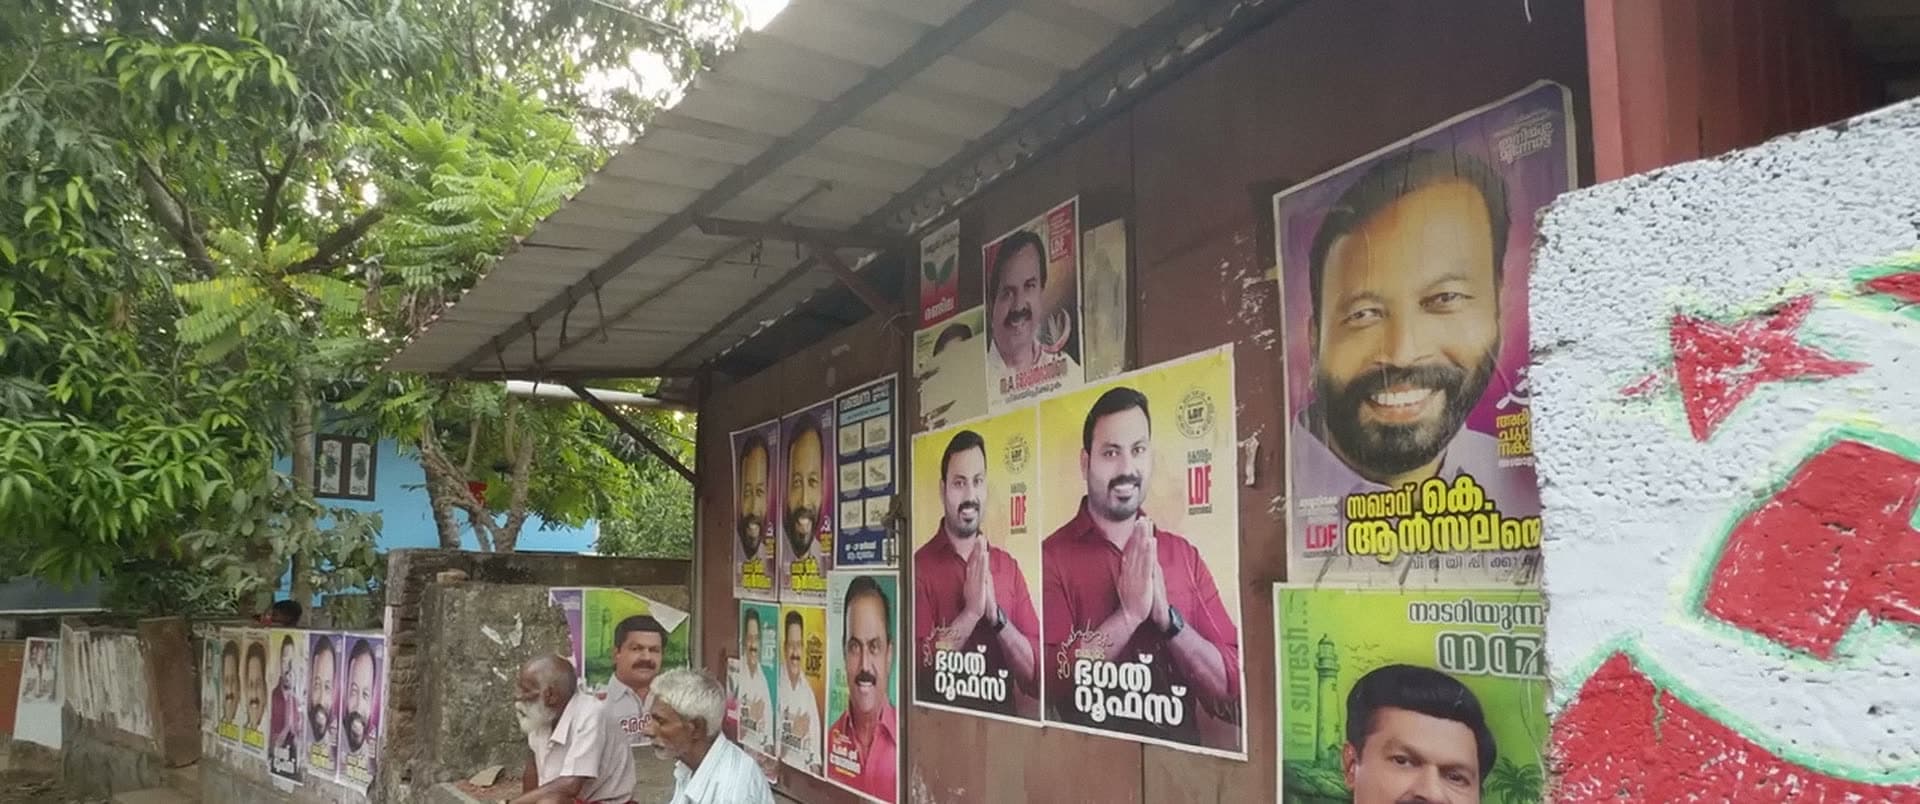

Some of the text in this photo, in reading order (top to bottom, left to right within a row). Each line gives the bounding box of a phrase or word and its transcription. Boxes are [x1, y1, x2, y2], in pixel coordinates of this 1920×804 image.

[1188, 465, 1212, 506] LDF
[1347, 483, 1415, 519] സഖാവ്
[1422, 475, 1494, 514] കെ.
[1010, 495, 1027, 527] LDF
[1306, 524, 1338, 549] LDF
[1409, 599, 1544, 630] നാടറിയുന്ന
[935, 644, 987, 676] ഭഗത്
[1074, 653, 1154, 693] ഭഗത്
[935, 668, 1009, 702] റൂഫസ്
[1074, 685, 1187, 727] റൂഫസ്
